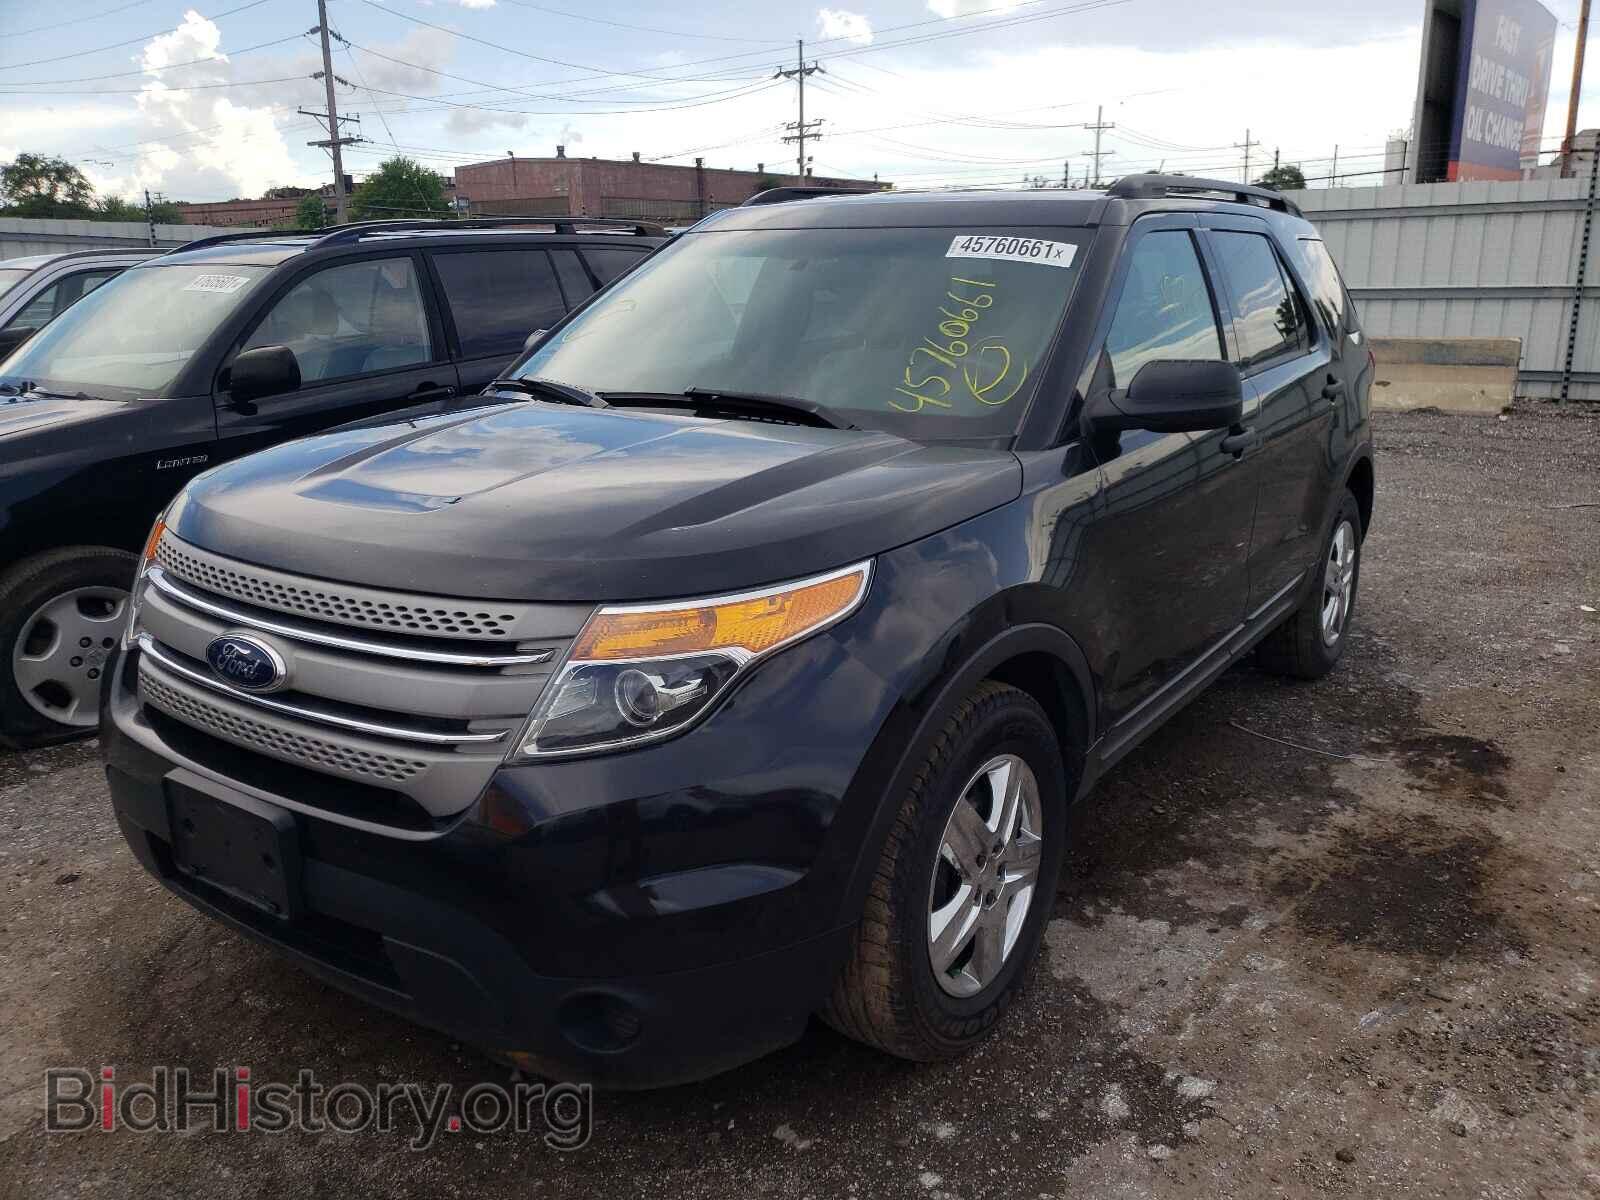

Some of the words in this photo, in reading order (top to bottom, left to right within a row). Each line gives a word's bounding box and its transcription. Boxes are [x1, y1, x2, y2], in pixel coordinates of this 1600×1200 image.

[1471, 55, 1504, 99] DRIVE
[1466, 105, 1483, 142] OIL
[1484, 112, 1525, 152] CHANGE
[216, 642, 261, 680] Ford
